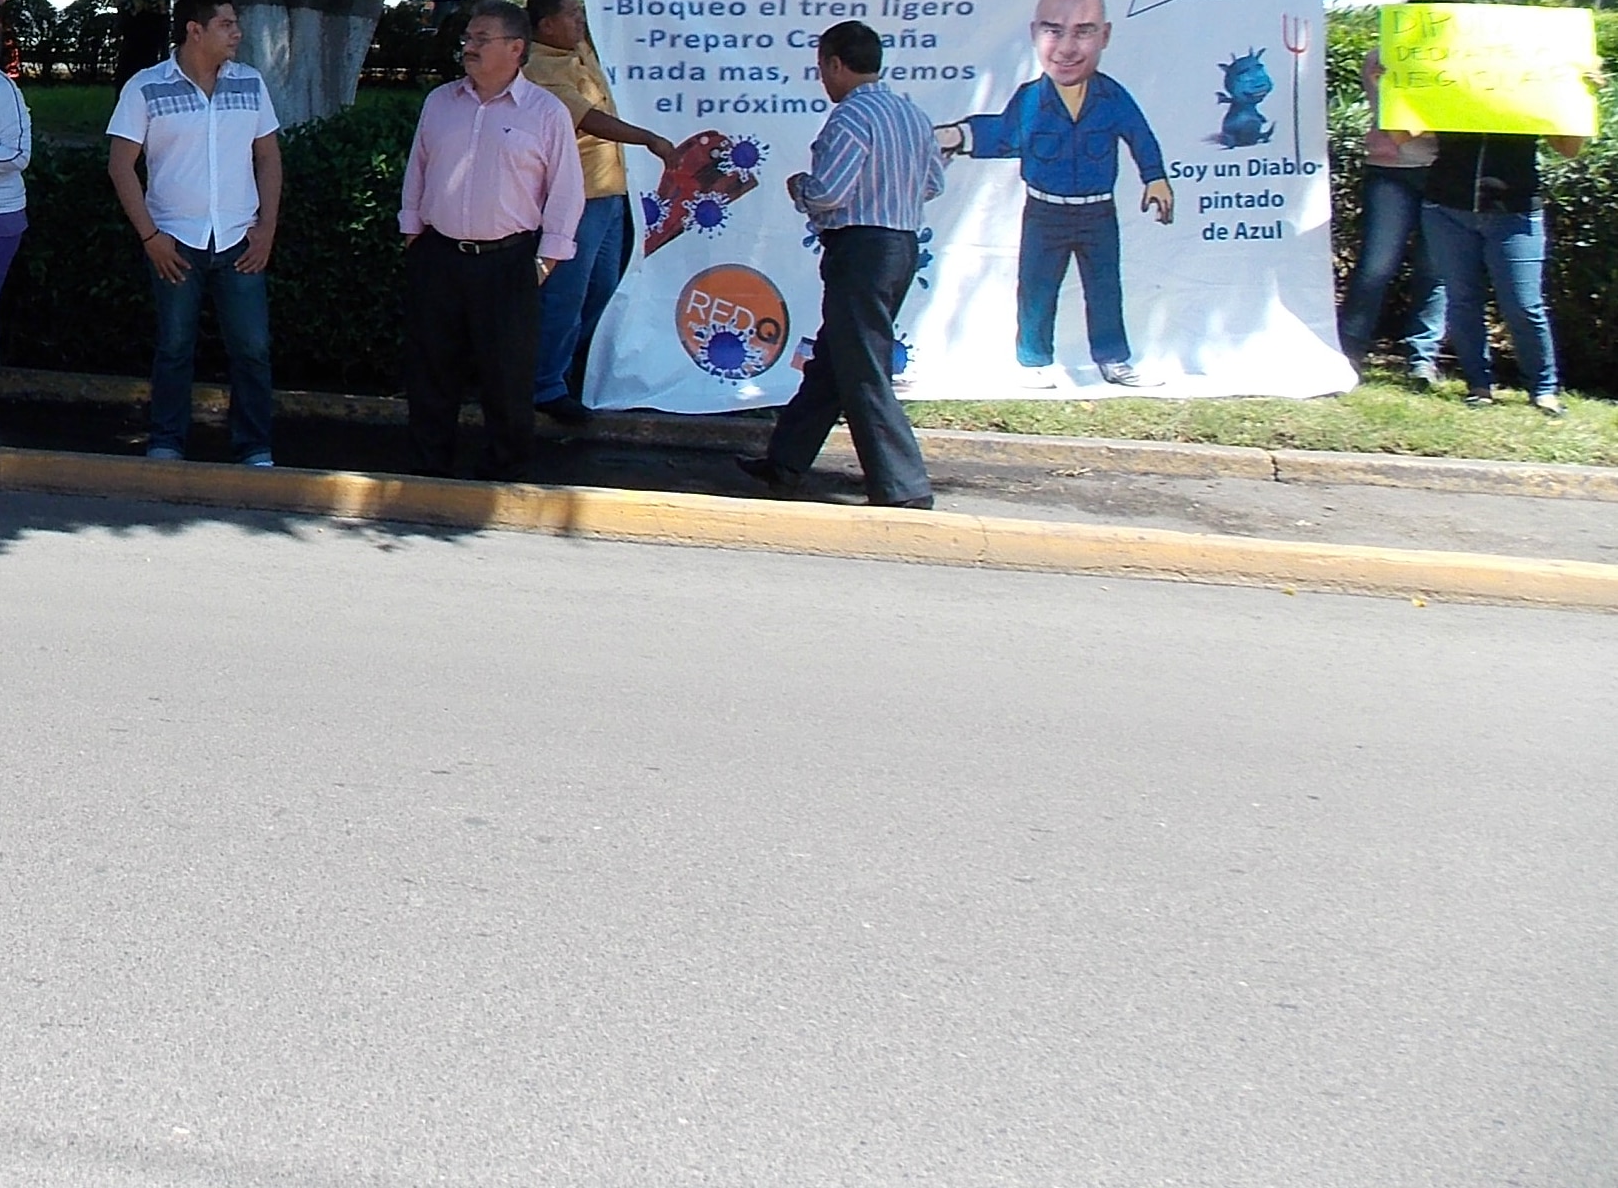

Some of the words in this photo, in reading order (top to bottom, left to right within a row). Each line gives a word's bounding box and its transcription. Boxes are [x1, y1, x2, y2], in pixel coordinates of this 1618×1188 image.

[634, 29, 774, 52] -Preparo
[786, 28, 938, 48] Caaña
[605, 65, 617, 85] y
[627, 61, 706, 81] nada
[718, 65, 790, 84] mas,
[655, 93, 683, 112] el
[696, 92, 828, 117] próximo
[1169, 161, 1208, 182] Soy
[1214, 163, 1240, 177] un
[1198, 188, 1285, 213] pintado
[1202, 222, 1229, 240] de
[1234, 220, 1283, 240] Azul
